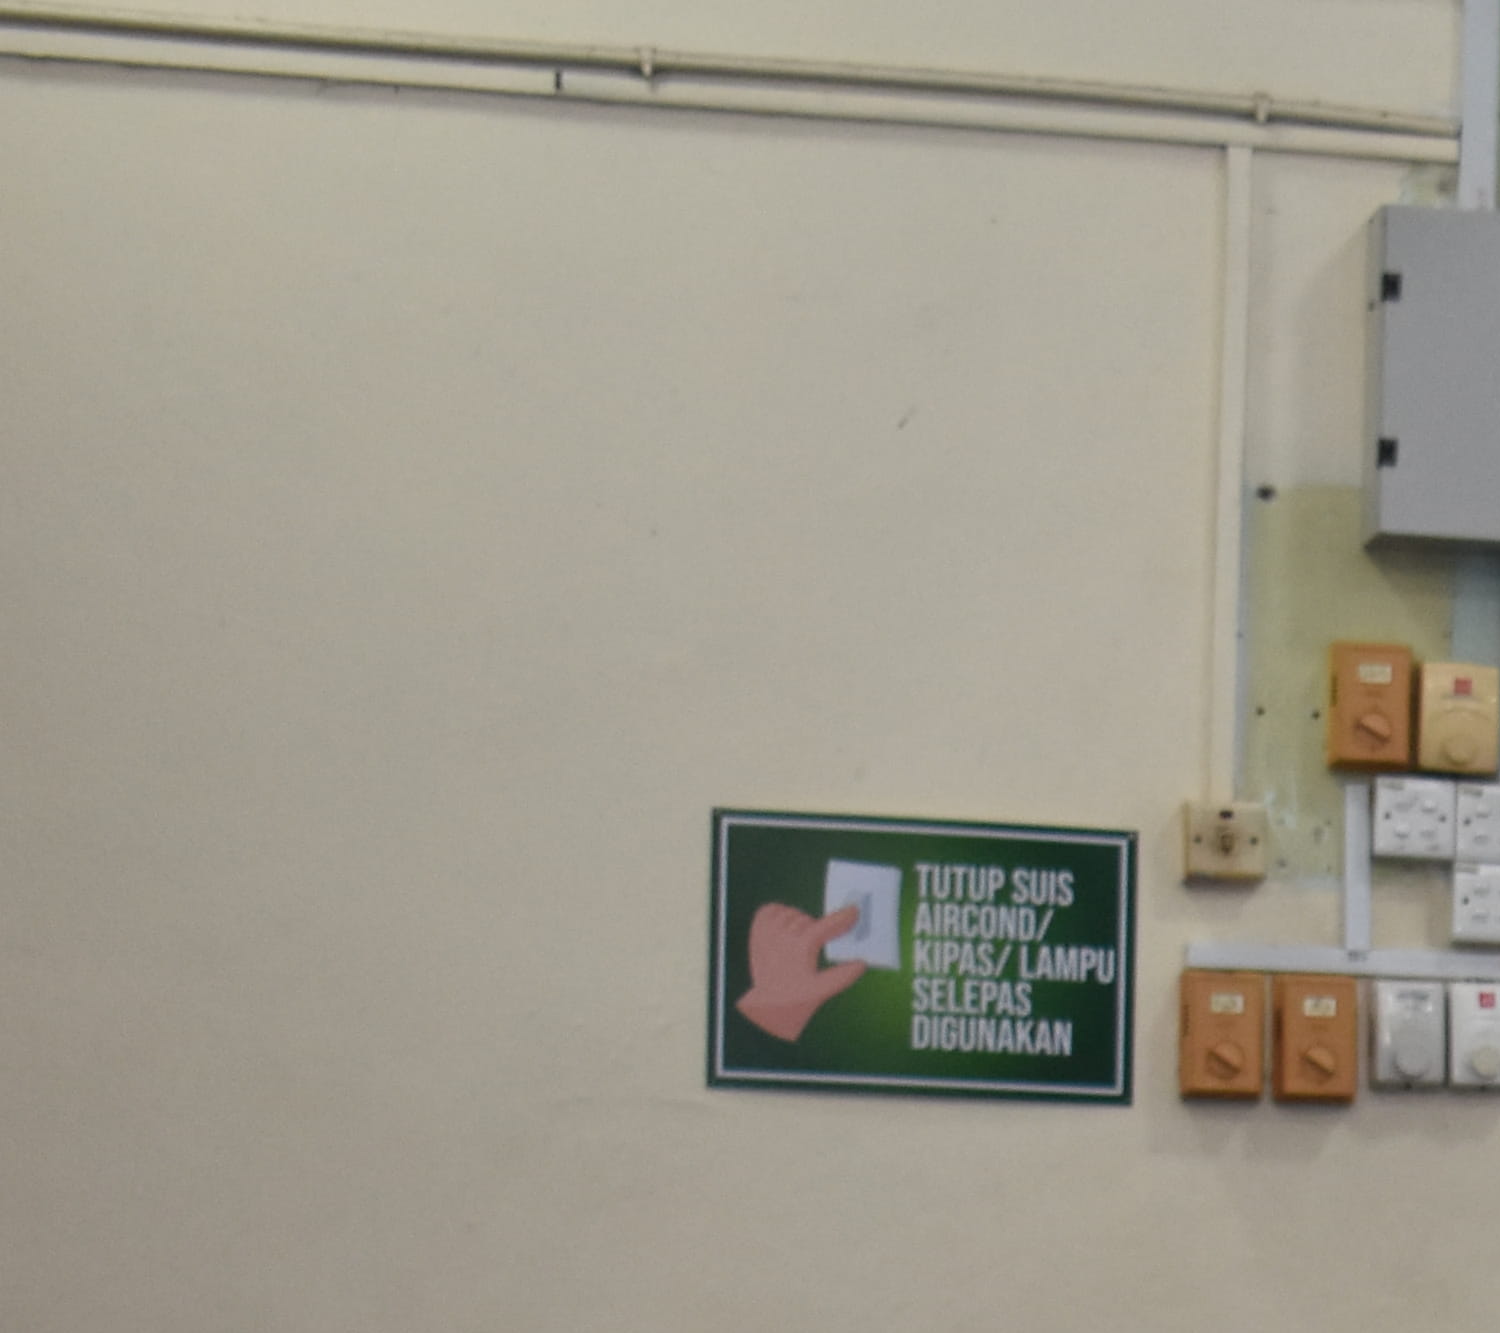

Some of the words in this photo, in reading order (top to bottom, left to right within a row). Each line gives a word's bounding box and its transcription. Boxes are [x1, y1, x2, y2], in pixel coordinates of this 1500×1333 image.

[915, 863, 1005, 901] TUTUP
[1011, 868, 1075, 907] SUIS
[914, 902, 1055, 942] AIRCOND/
[914, 939, 1012, 977] KIPAS/
[1019, 945, 1115, 985] LAMPU
[913, 976, 1032, 1017] SELEPAS
[912, 1014, 1073, 1057] DIGUNAKAN
